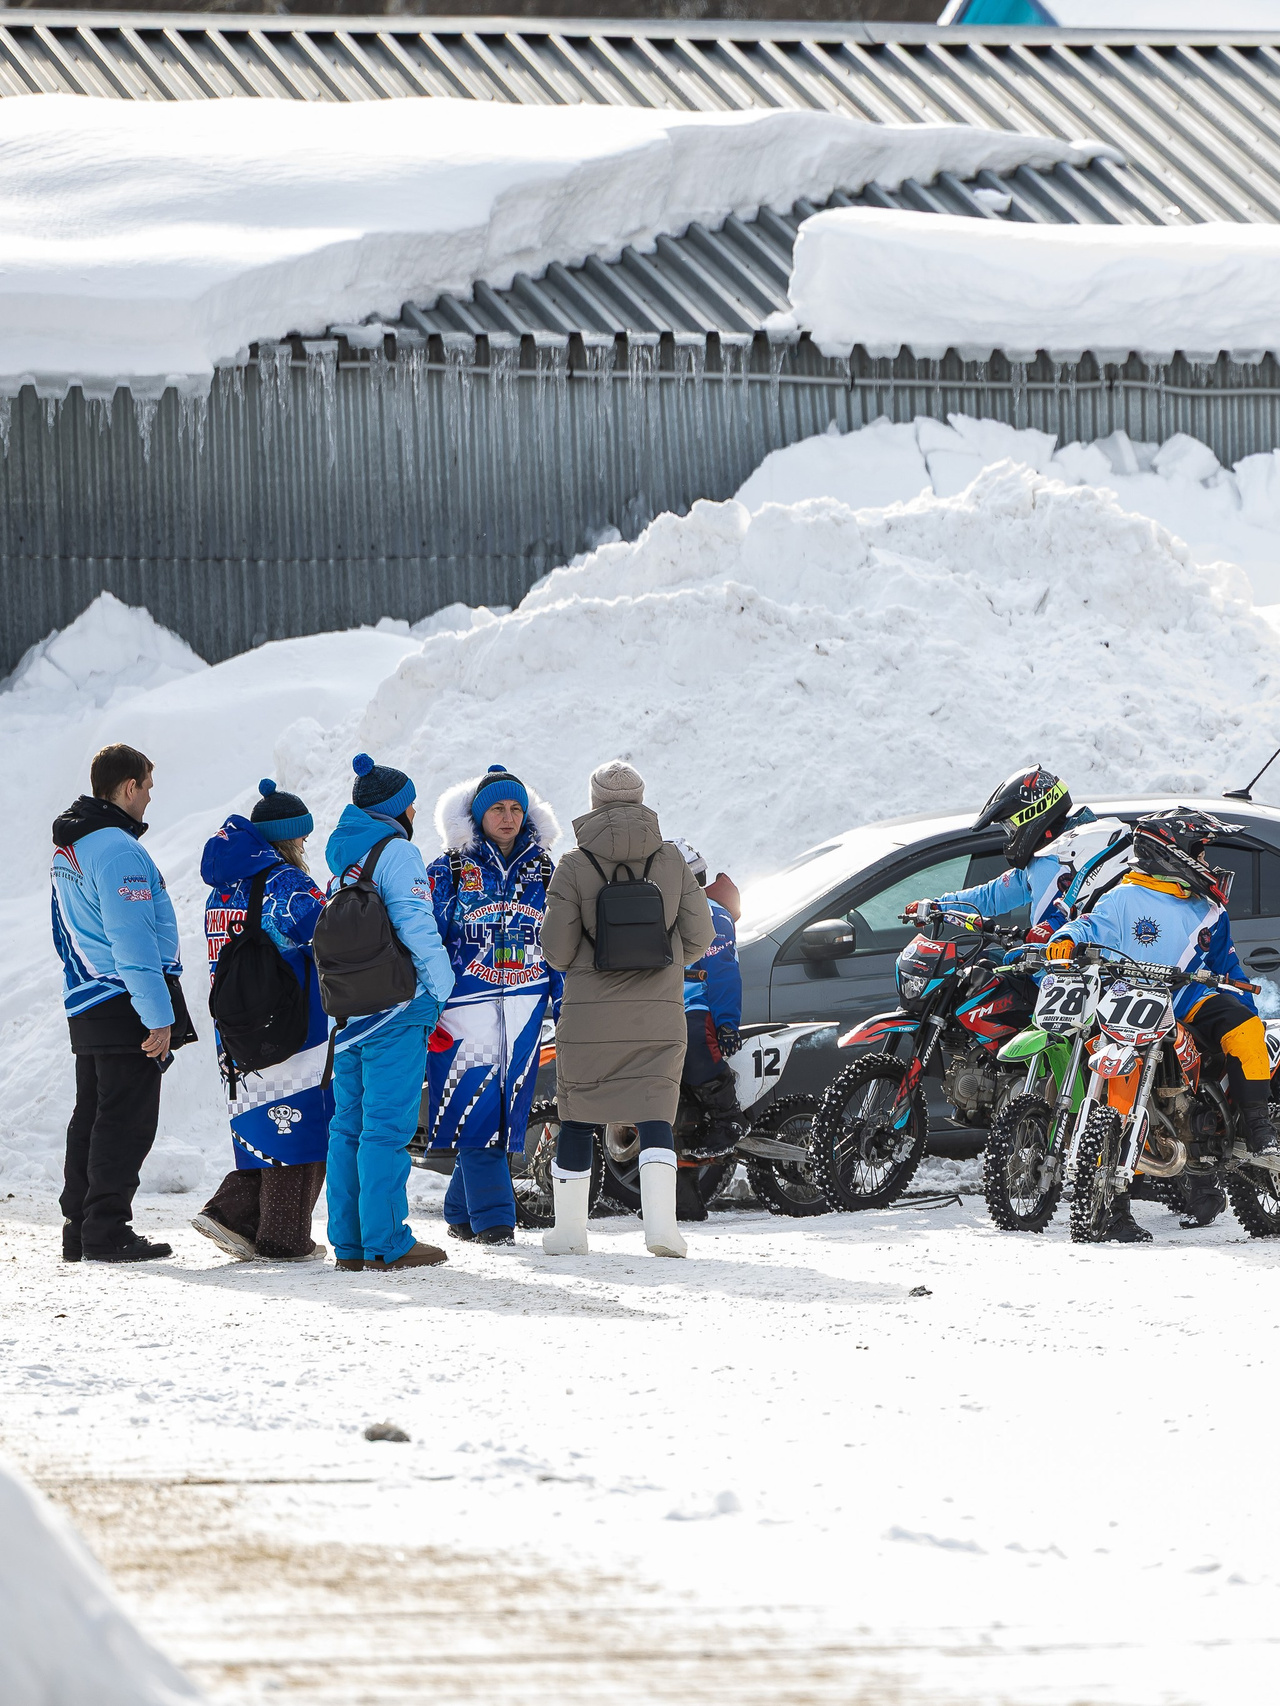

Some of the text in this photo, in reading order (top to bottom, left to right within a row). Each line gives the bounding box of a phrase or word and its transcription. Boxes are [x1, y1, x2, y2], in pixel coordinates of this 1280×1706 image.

[1015, 790, 1060, 824] 100%
[1071, 866, 1089, 898] HIZER
[1037, 986, 1091, 1016] 28
[1106, 995, 1165, 1030] 10
[751, 1047, 781, 1079] 12
